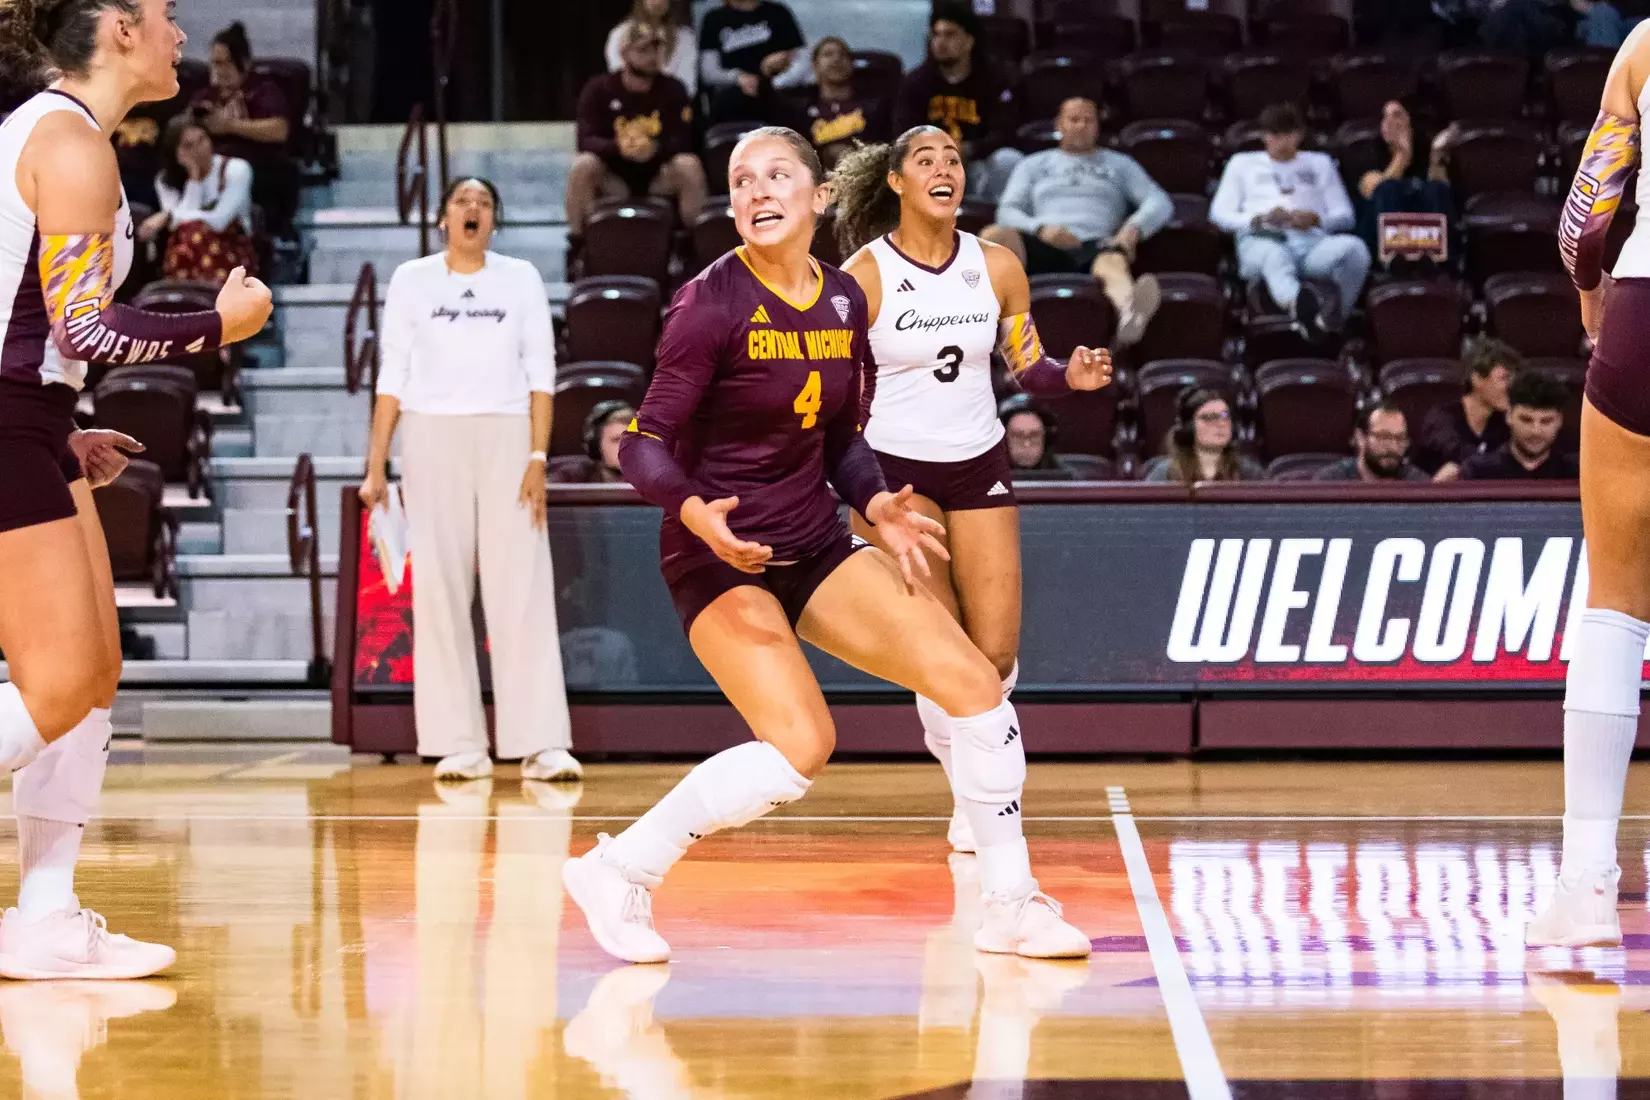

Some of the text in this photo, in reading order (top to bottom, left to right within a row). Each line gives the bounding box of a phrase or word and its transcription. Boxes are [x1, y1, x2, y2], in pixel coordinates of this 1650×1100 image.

[1558, 169, 1600, 285] CHIPPEW
[65, 298, 173, 364] CHIPPEWAS
[748, 329, 804, 360] CENTRAL
[895, 309, 989, 332] Chippewas
[933, 345, 964, 383] 3
[794, 371, 822, 429] 4
